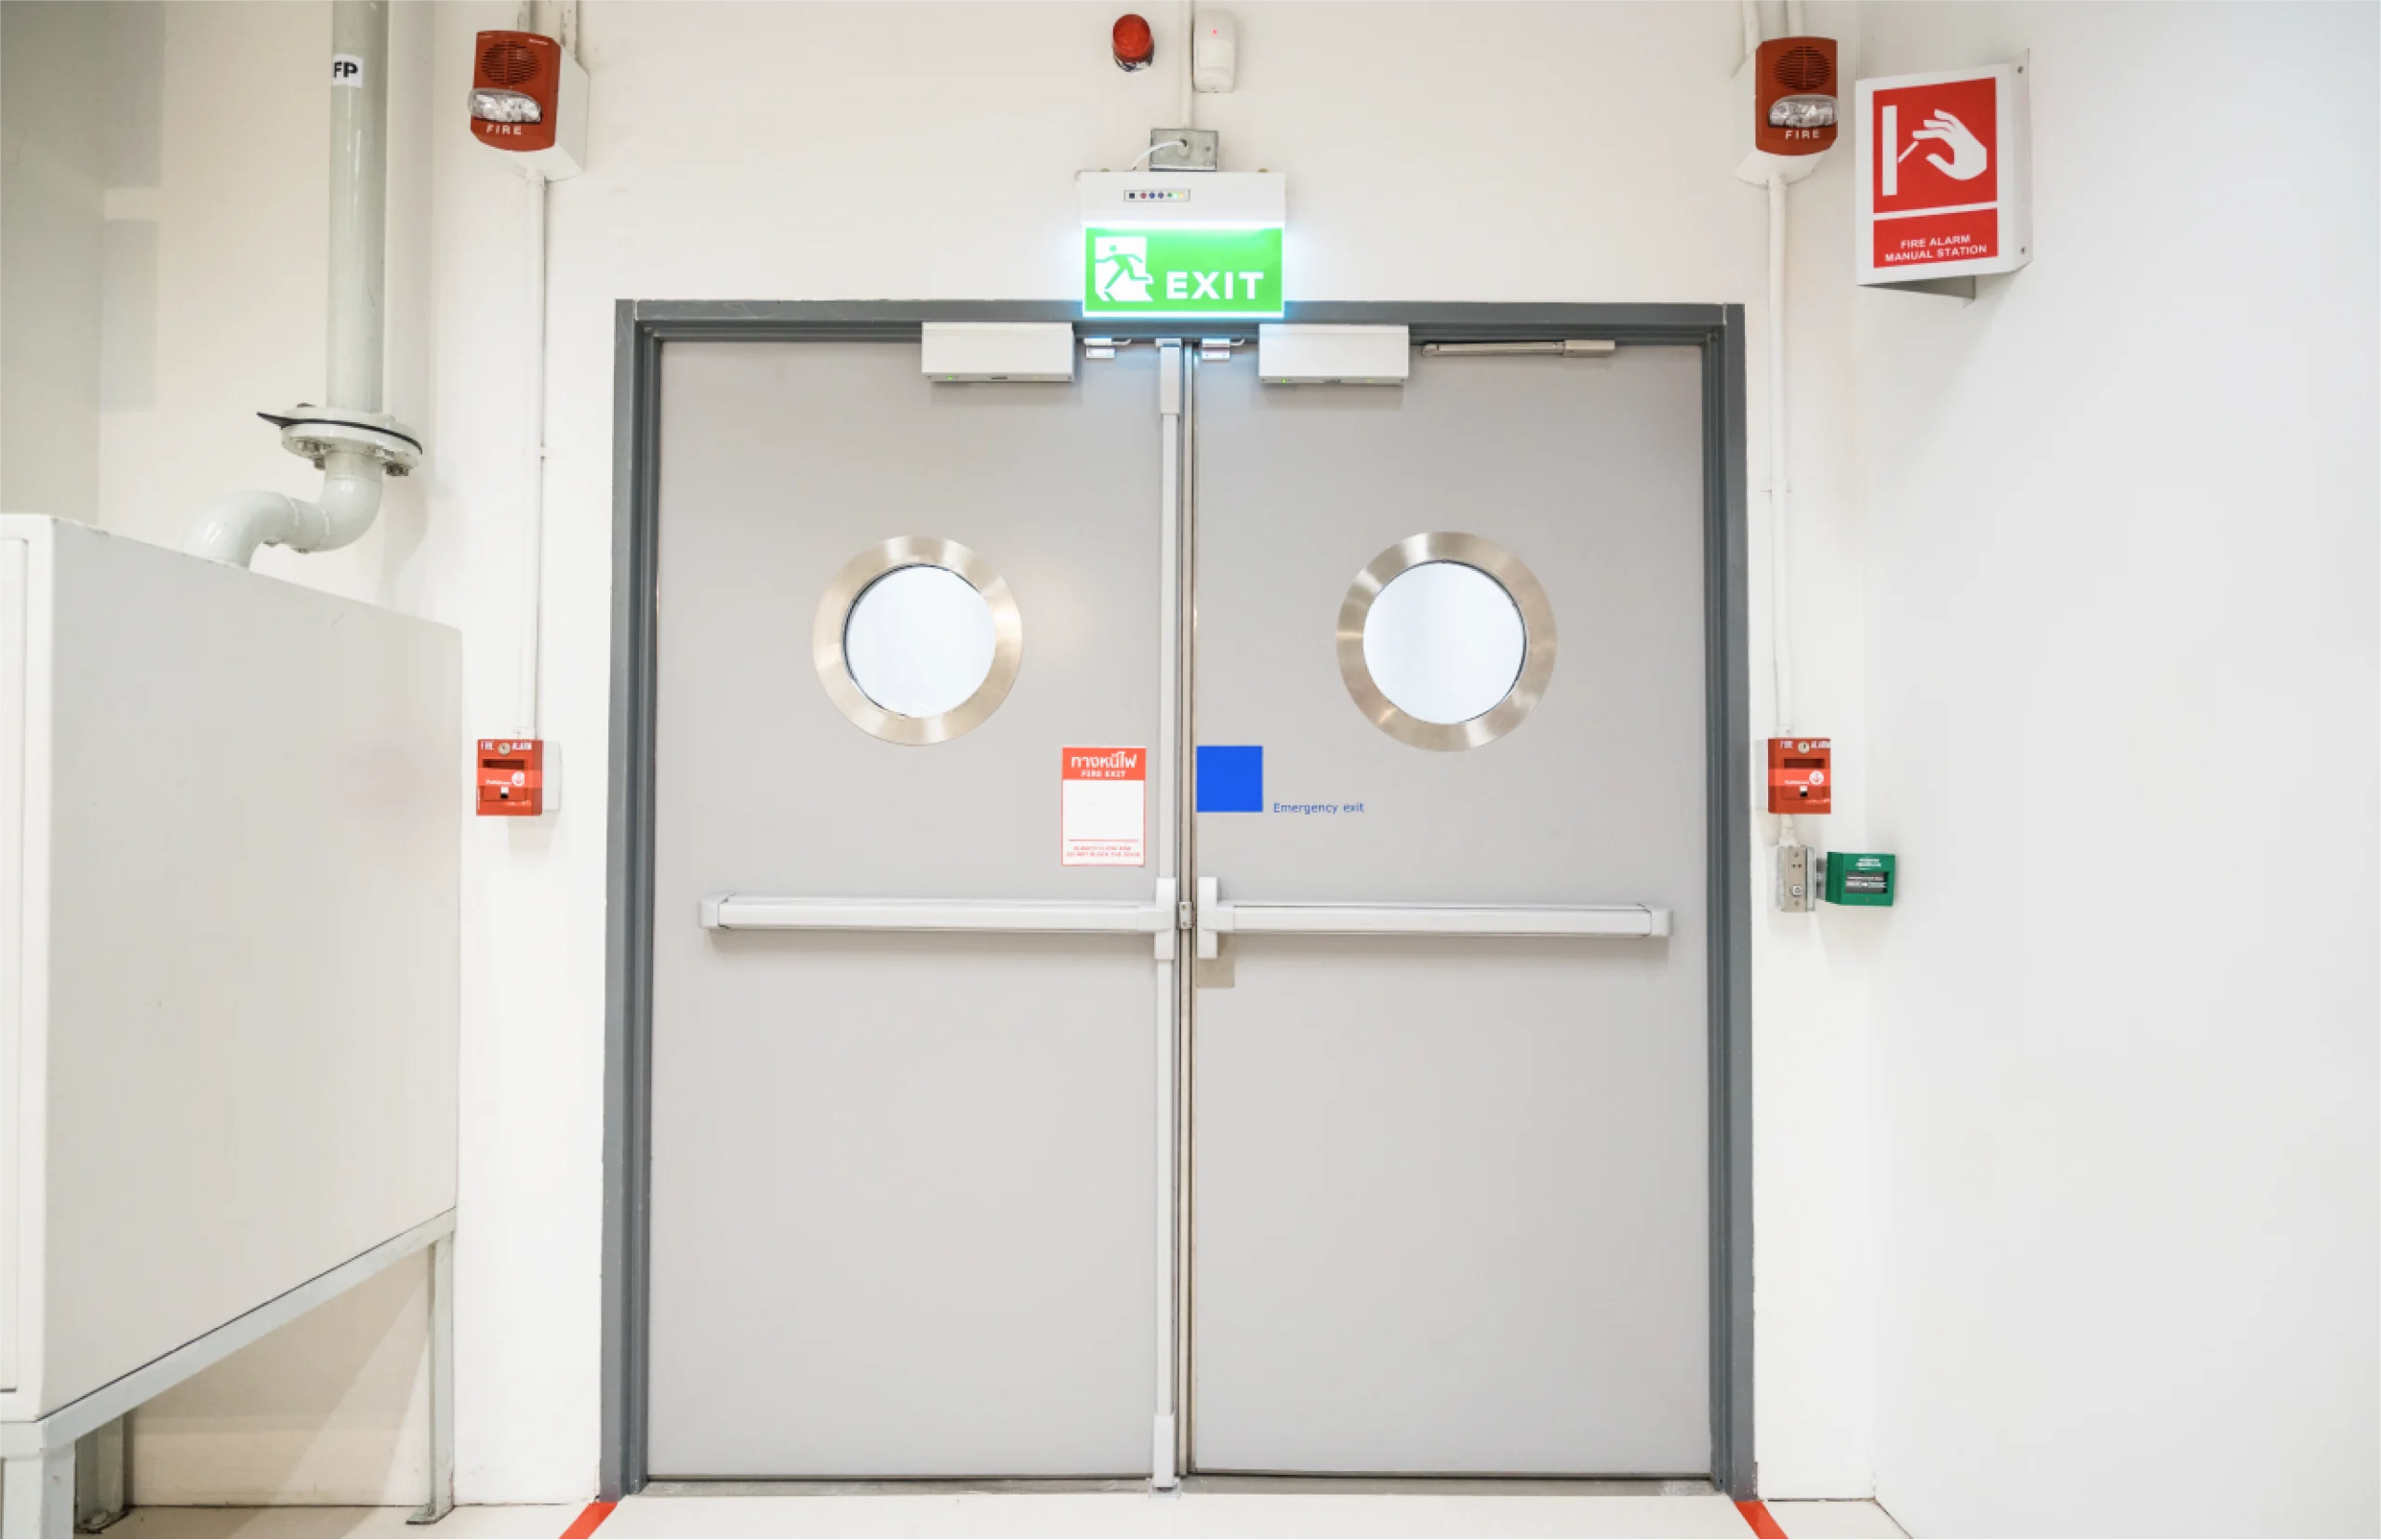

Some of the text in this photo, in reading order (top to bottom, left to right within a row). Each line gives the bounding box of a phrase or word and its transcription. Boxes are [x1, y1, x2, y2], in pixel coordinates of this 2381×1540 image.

[333, 60, 358, 78] FP
[486, 125, 522, 135] FIRE
[1786, 129, 1820, 139] FIRE
[1900, 234, 1971, 249] FIRE ALARM
[1884, 245, 1988, 262] MANUAL STATION
[1166, 271, 1264, 299] EXIT
[1081, 769, 1126, 777] FIRE EXIT
[1273, 803, 1364, 815] Emergency exit
